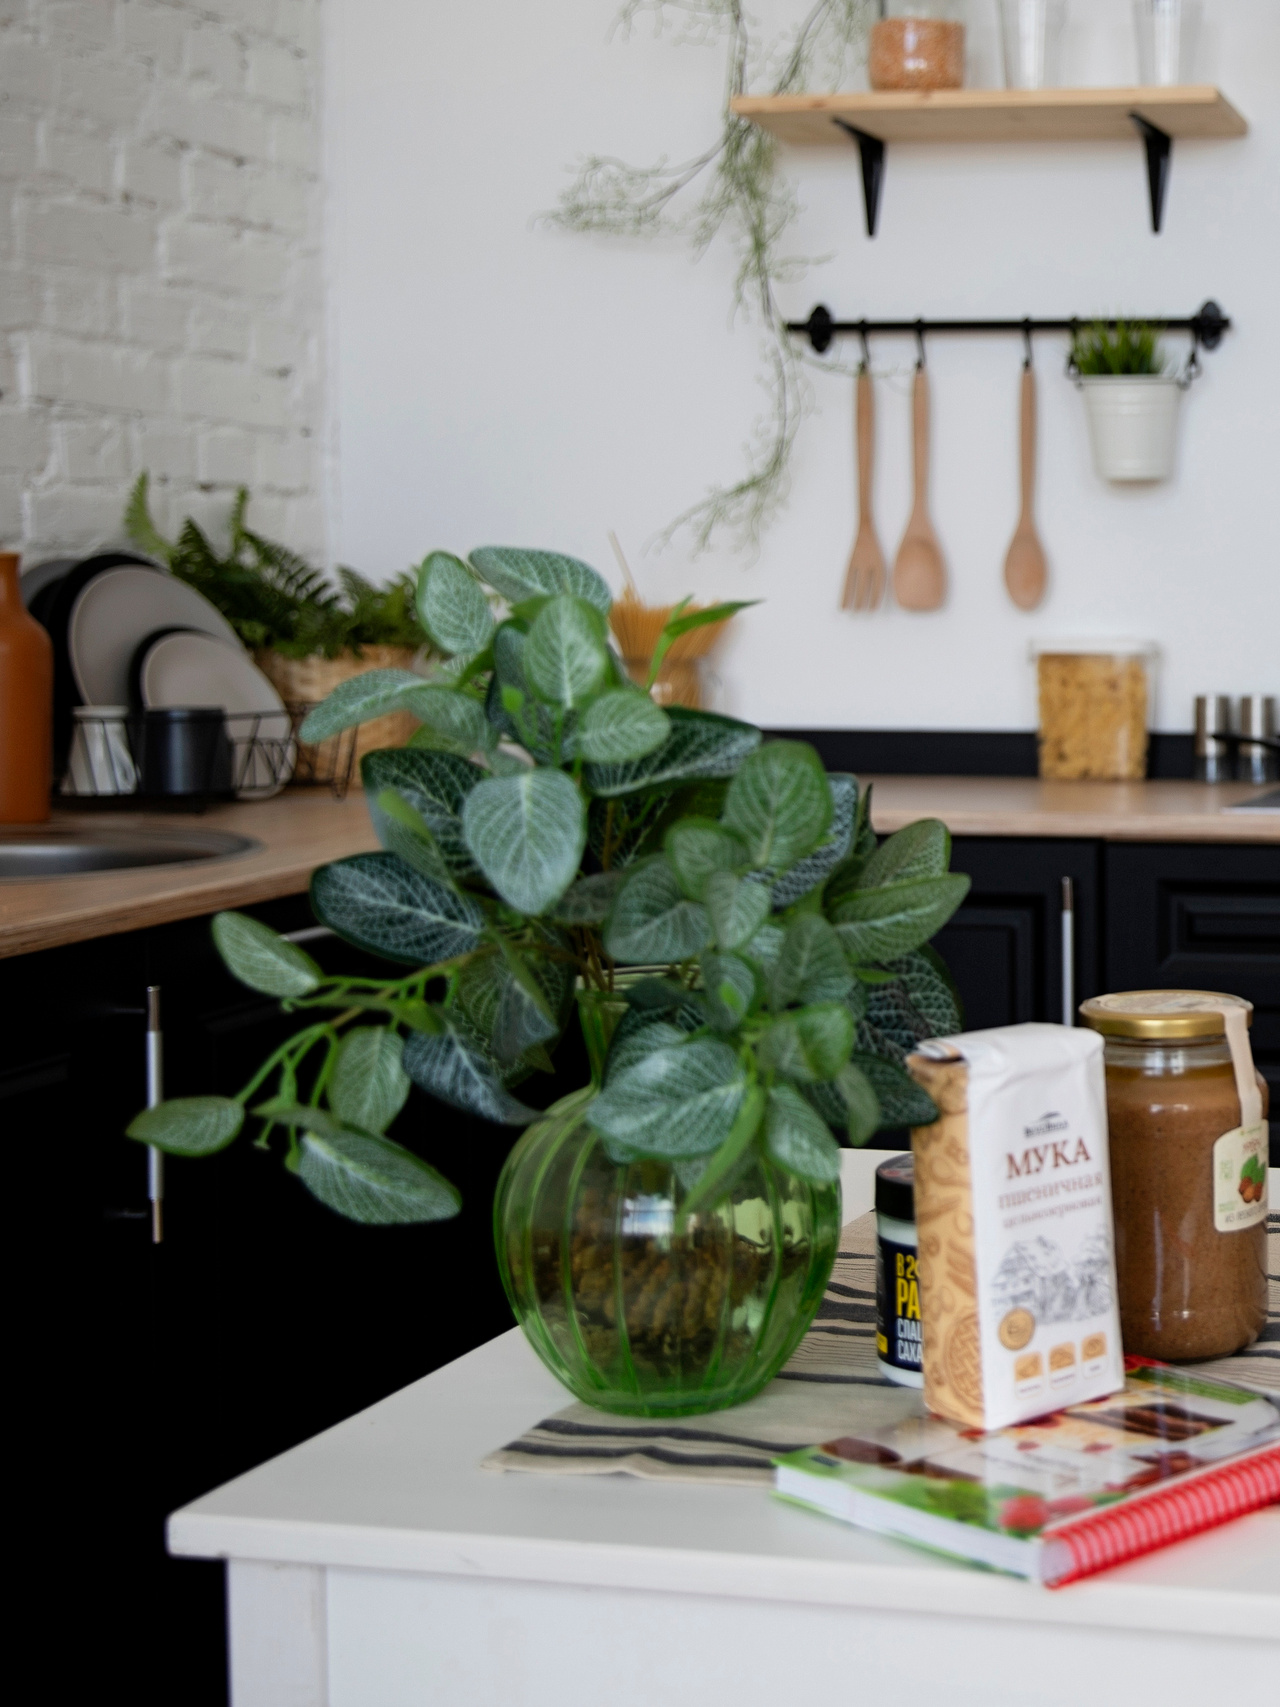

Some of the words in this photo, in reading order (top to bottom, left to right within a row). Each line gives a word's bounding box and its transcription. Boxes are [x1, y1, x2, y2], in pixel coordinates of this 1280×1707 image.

[1006, 1136, 1091, 1180] МУКА
[896, 1252, 905, 1277] В
[896, 1277, 921, 1320] РА
[897, 1339, 923, 1363] САХА
